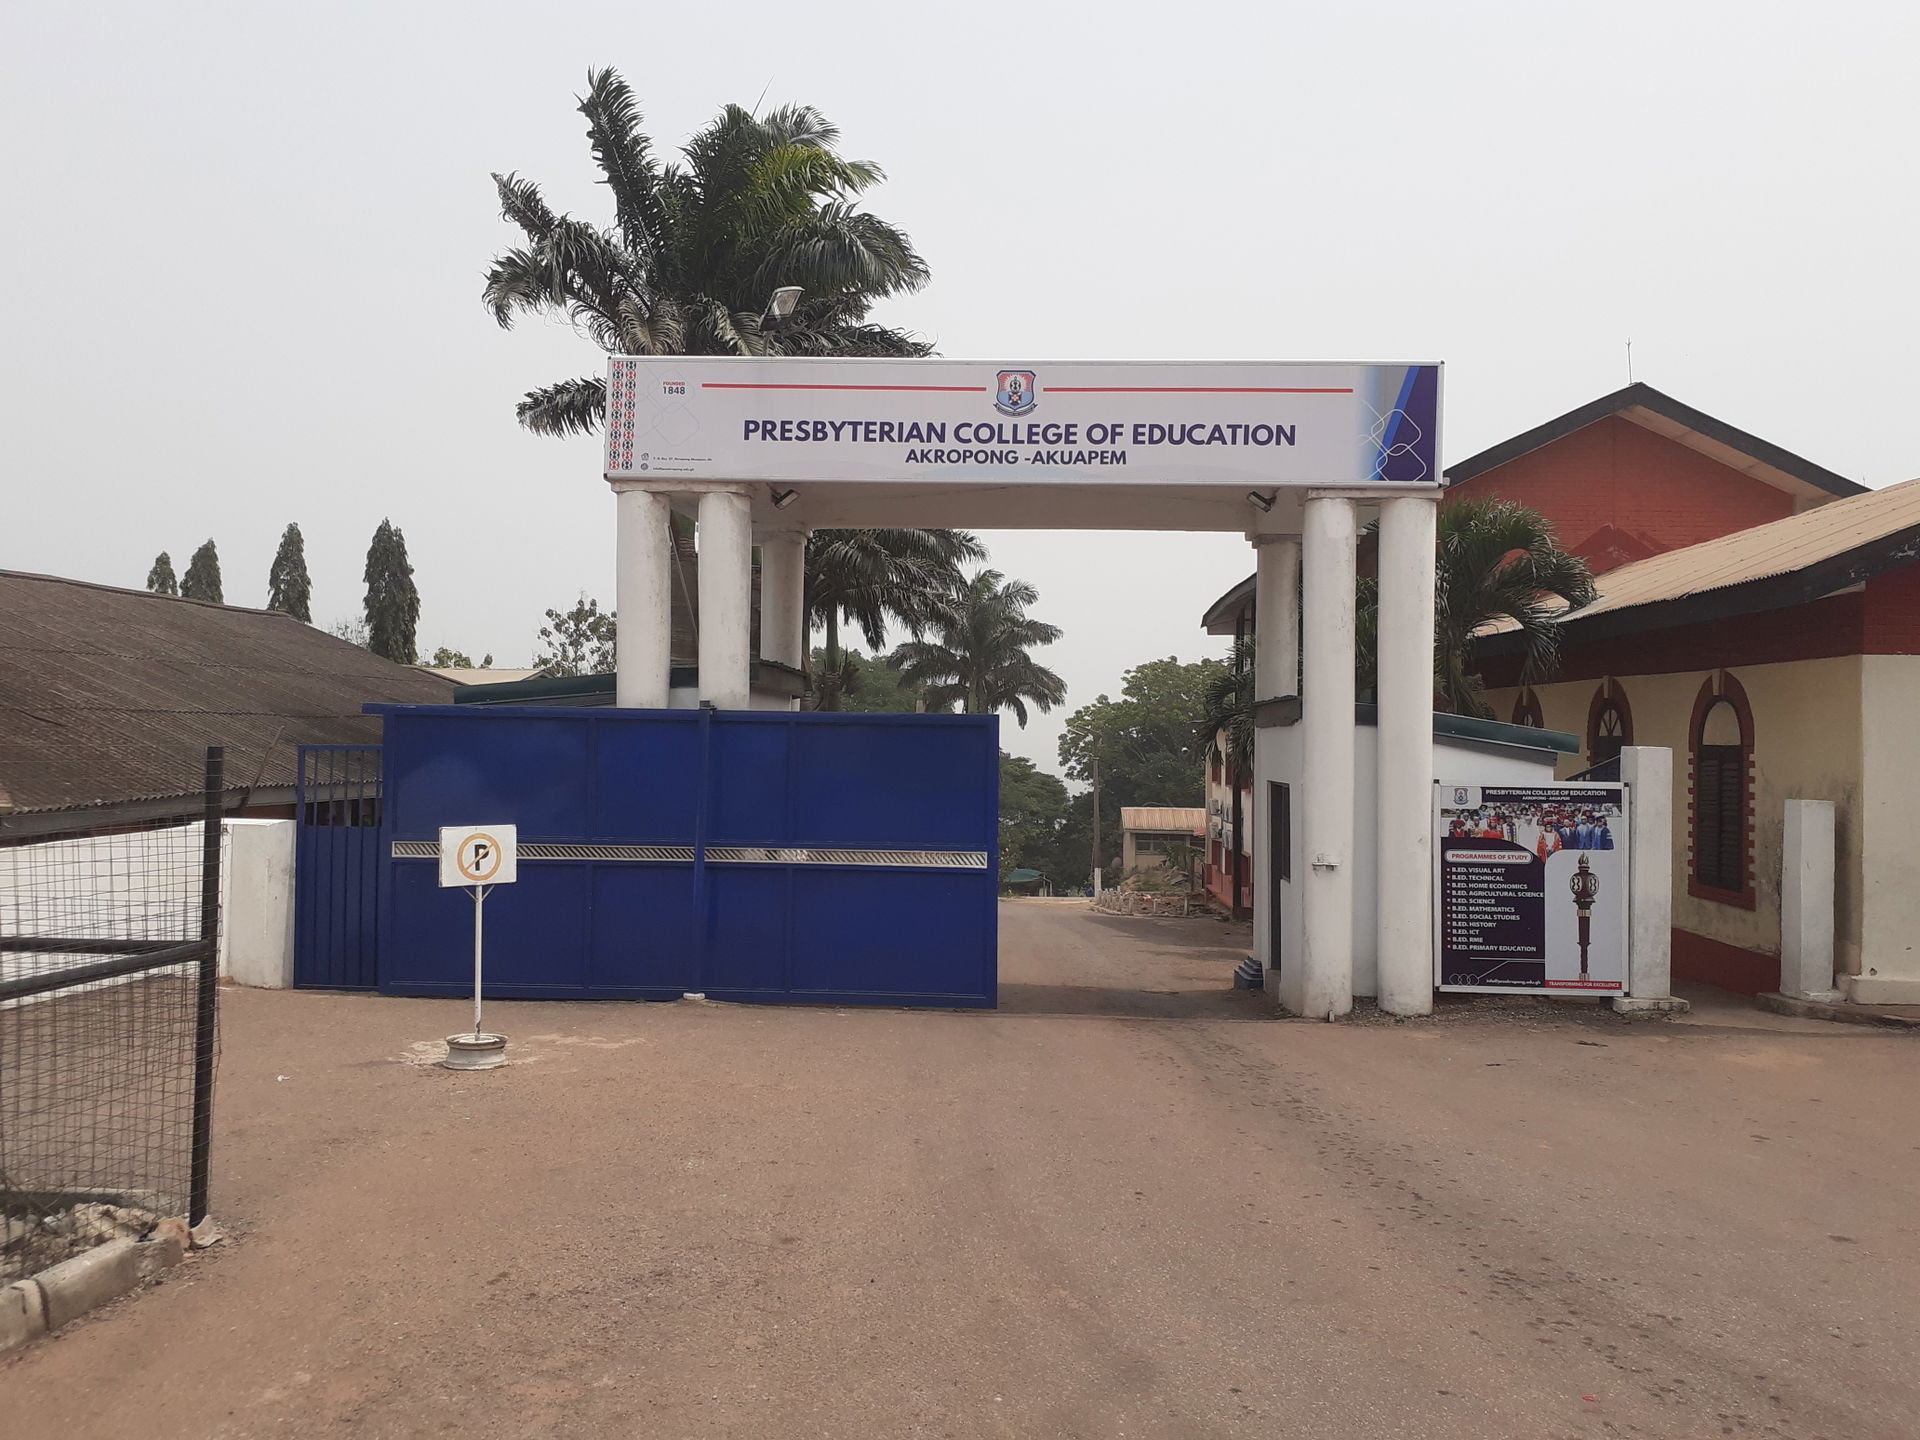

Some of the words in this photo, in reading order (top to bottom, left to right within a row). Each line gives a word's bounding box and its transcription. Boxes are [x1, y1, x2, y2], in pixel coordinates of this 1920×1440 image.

[662, 386, 686, 394] 1848
[743, 419, 946, 444] PRESBYTERIAN
[954, 422, 1078, 446] COLLEGE
[1085, 423, 1124, 446] OF
[1132, 424, 1297, 447] EDUCATION
[905, 448, 1019, 465] AKROPONG
[474, 844, 490, 871] P
